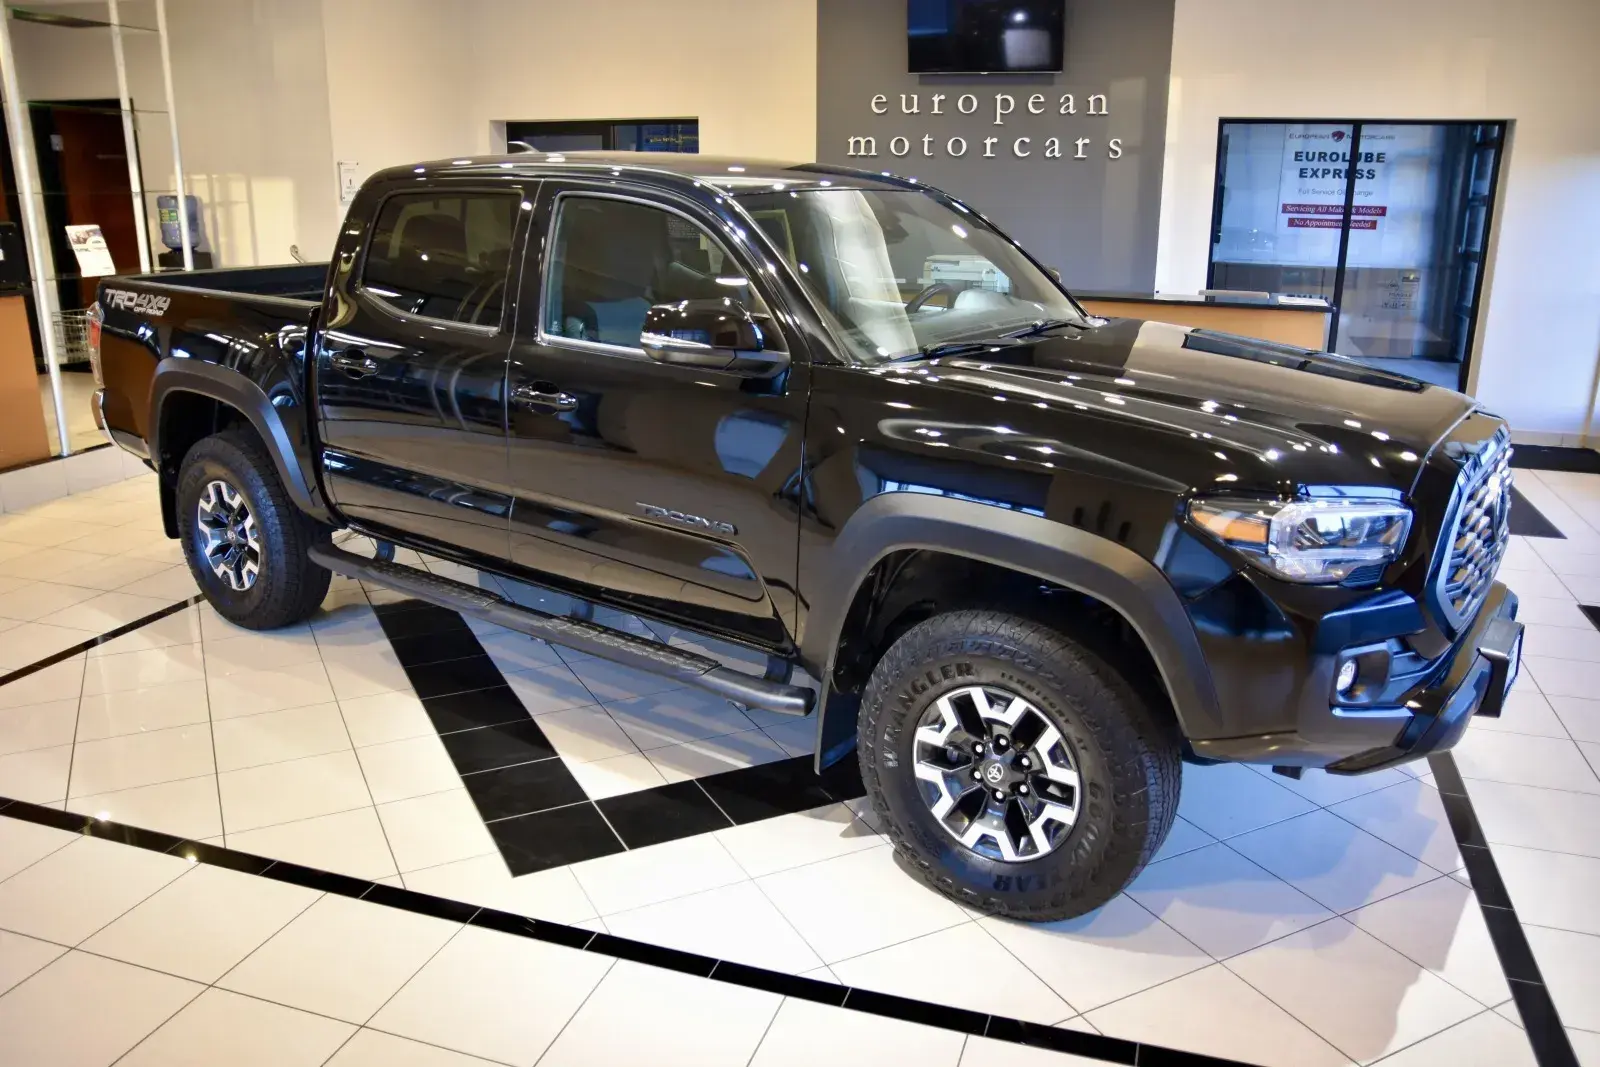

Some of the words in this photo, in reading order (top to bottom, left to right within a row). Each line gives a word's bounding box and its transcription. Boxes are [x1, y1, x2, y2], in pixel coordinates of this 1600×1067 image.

[870, 93, 1109, 124] european
[847, 133, 1122, 159] motorcars
[1311, 188, 1335, 196] Service
[1286, 205, 1315, 214] Servicing
[1304, 219, 1343, 228] Appointmen
[105, 288, 138, 311] TRD
[133, 306, 147, 314] OFF
[146, 308, 164, 317] ROAD
[636, 501, 739, 536] TACOMA
[882, 661, 976, 770] WRANGLER
